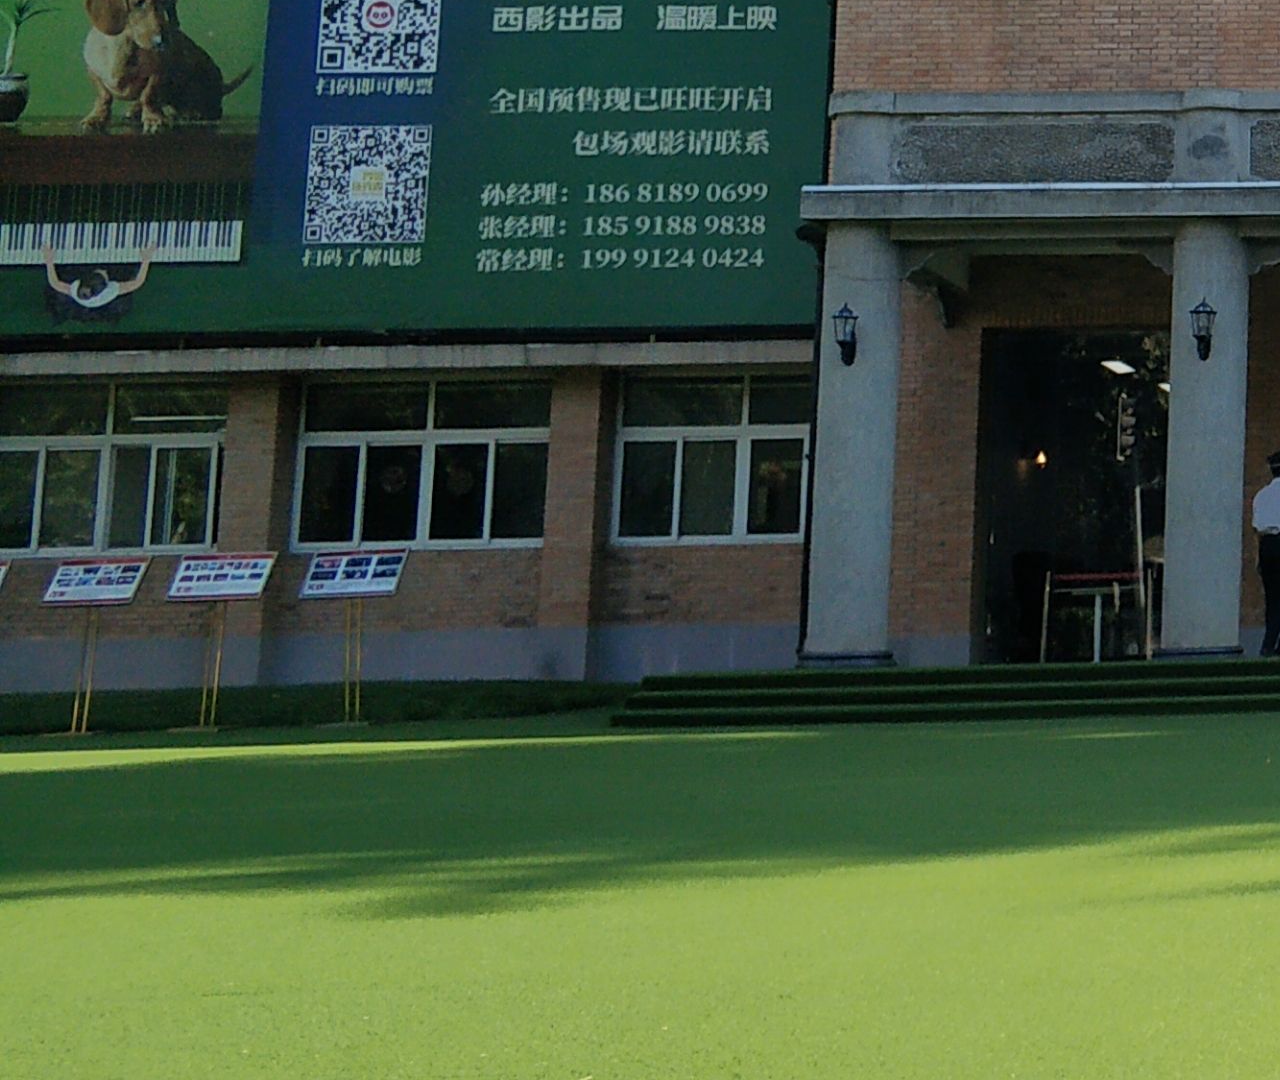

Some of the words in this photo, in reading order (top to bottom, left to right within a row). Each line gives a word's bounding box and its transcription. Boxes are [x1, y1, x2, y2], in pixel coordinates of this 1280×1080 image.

[492, 5, 623, 32] 西影出品
[656, 5, 778, 31] 温暖上映
[315, 76, 434, 96] 扫码即可购票
[489, 86, 773, 114] 全国预售现已旺旺开启
[572, 129, 771, 156] 包场观影请联系
[584, 183, 630, 203] 186
[636, 183, 700, 203] 8189
[706, 183, 769, 203] 0699
[582, 216, 629, 237] 185
[635, 215, 697, 236] 9188
[704, 215, 767, 236] 9838
[302, 247, 421, 268] 扫码了解电影
[581, 248, 627, 269] 199
[633, 248, 695, 268] 9124
[702, 248, 764, 268] 0424
